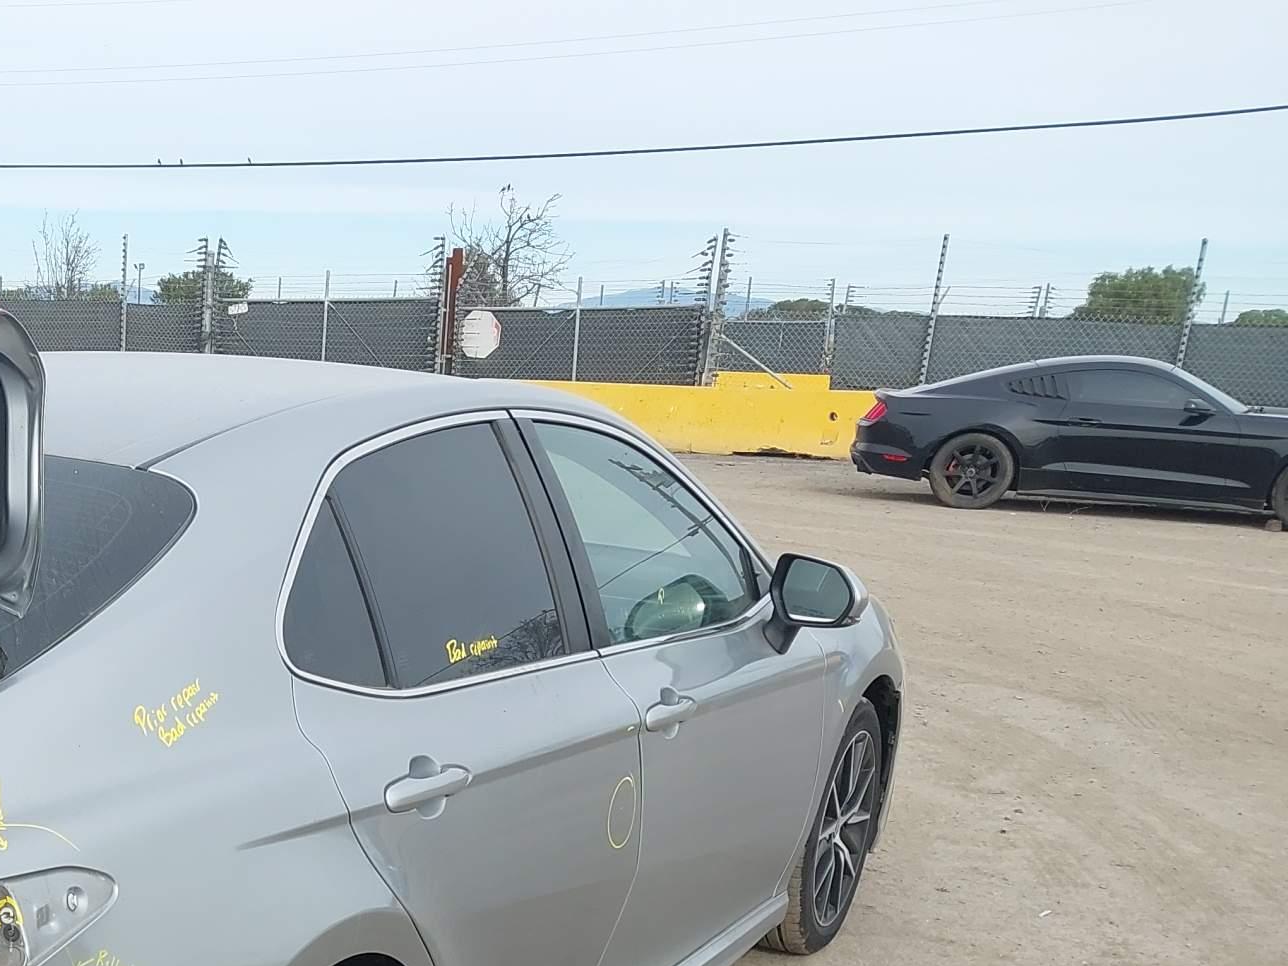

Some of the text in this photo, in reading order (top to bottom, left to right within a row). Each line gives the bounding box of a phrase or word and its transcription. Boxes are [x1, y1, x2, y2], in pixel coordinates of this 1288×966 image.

[445, 639, 466, 664] Bad
[133, 677, 201, 738] Prior repair
